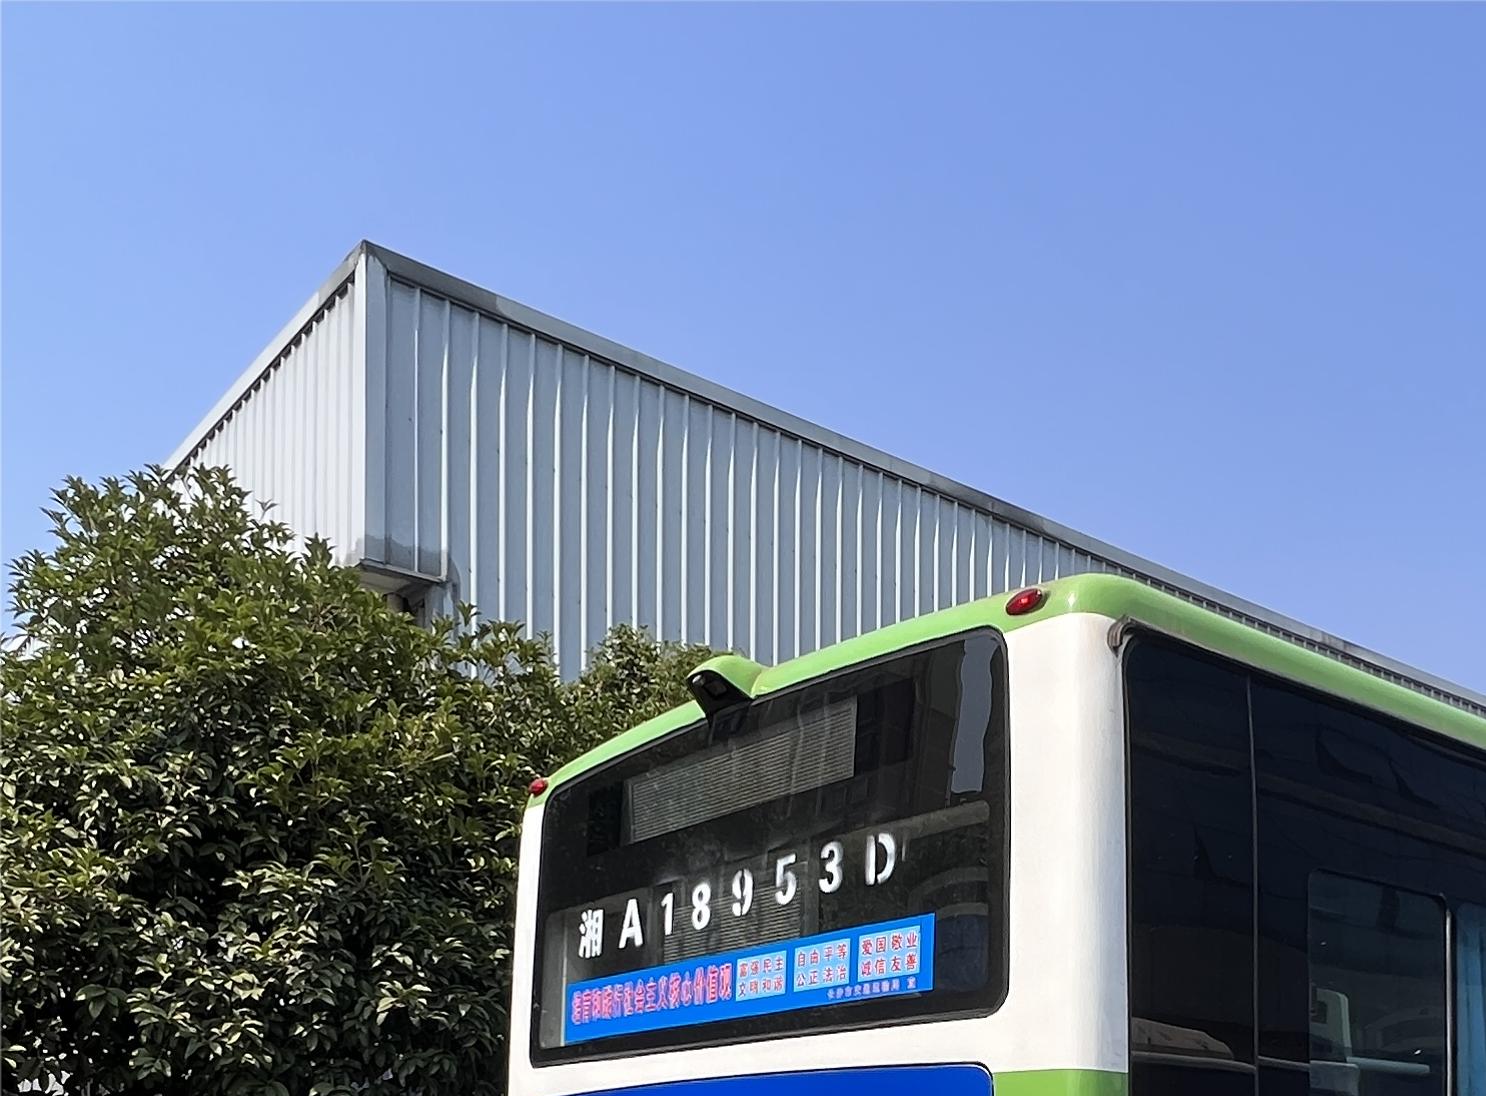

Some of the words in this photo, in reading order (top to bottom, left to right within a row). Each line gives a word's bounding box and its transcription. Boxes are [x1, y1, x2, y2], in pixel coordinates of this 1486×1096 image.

[797, 944, 848, 967] 自由平等
[861, 931, 921, 956] 爱国敬业
[796, 966, 848, 987] 公正法治
[860, 953, 919, 977] 诚信友善
